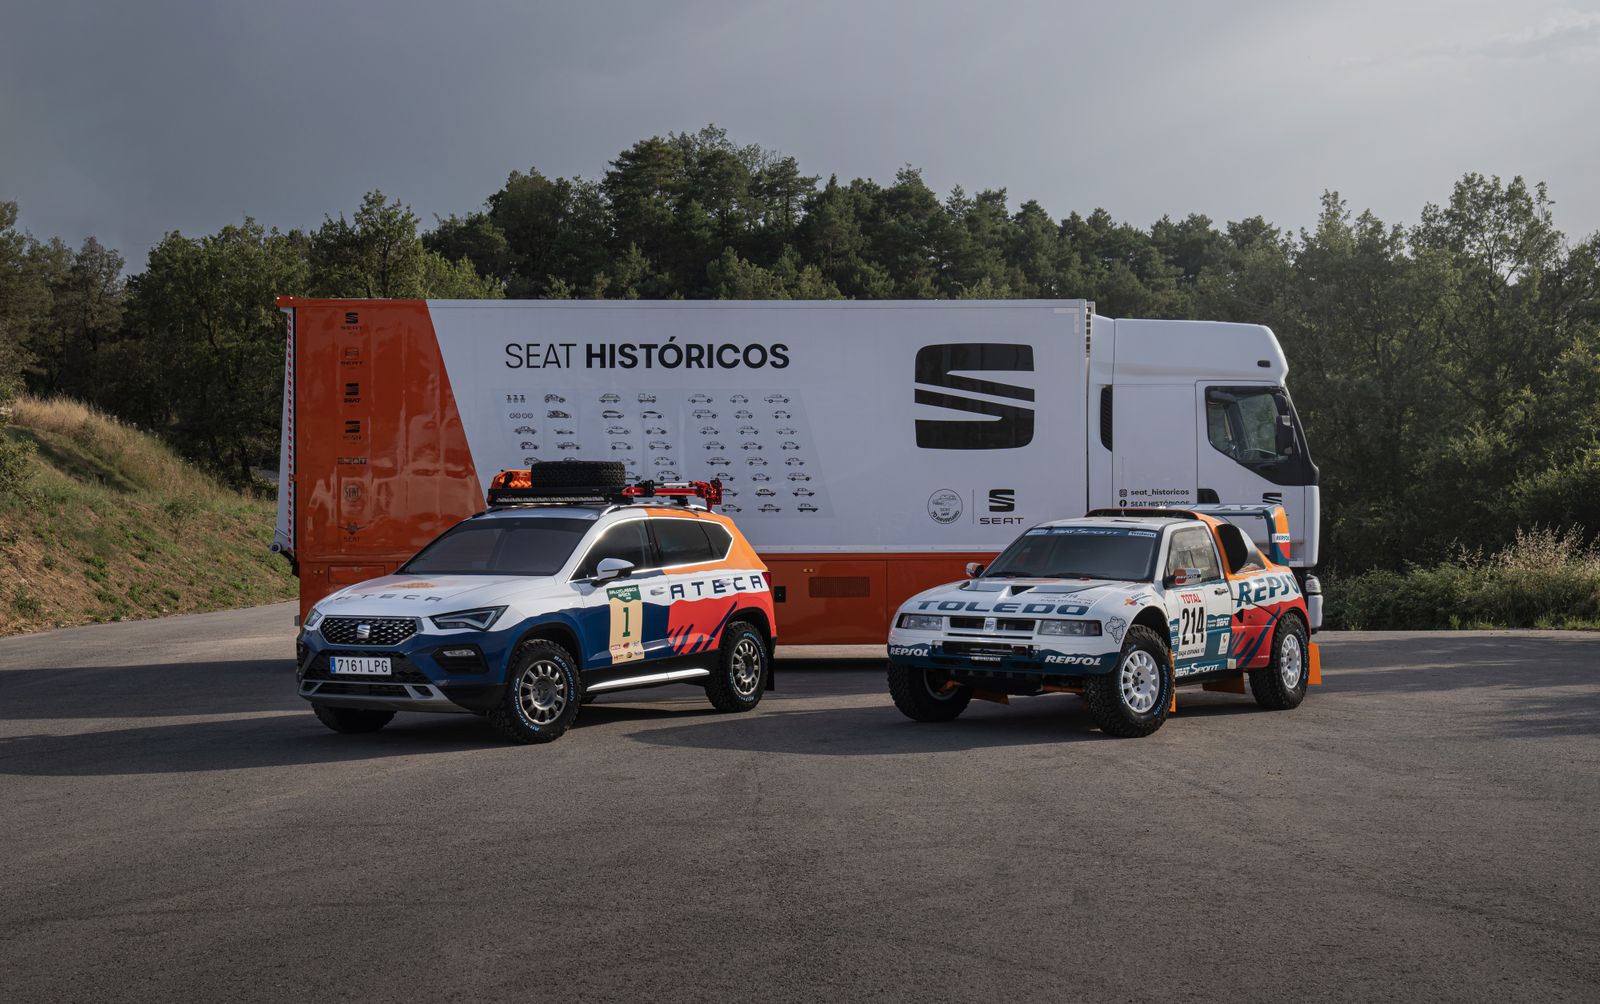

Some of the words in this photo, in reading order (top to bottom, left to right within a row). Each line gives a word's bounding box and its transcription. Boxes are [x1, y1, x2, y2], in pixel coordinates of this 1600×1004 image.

[505, 343, 577, 369] SEAT
[586, 336, 790, 369] HISTÓRICOS
[1131, 488, 1189, 496] seat_historicos
[670, 575, 763, 599] ATECA
[1181, 592, 1202, 604] TOTAL
[917, 600, 1090, 616] TOLEDO
[622, 606, 631, 638] 1
[1181, 606, 1205, 646] 214
[889, 646, 929, 657] REPSOL
[337, 659, 364, 672] 7161
[367, 660, 388, 672] LPG
[1044, 655, 1101, 666] REPSOL
